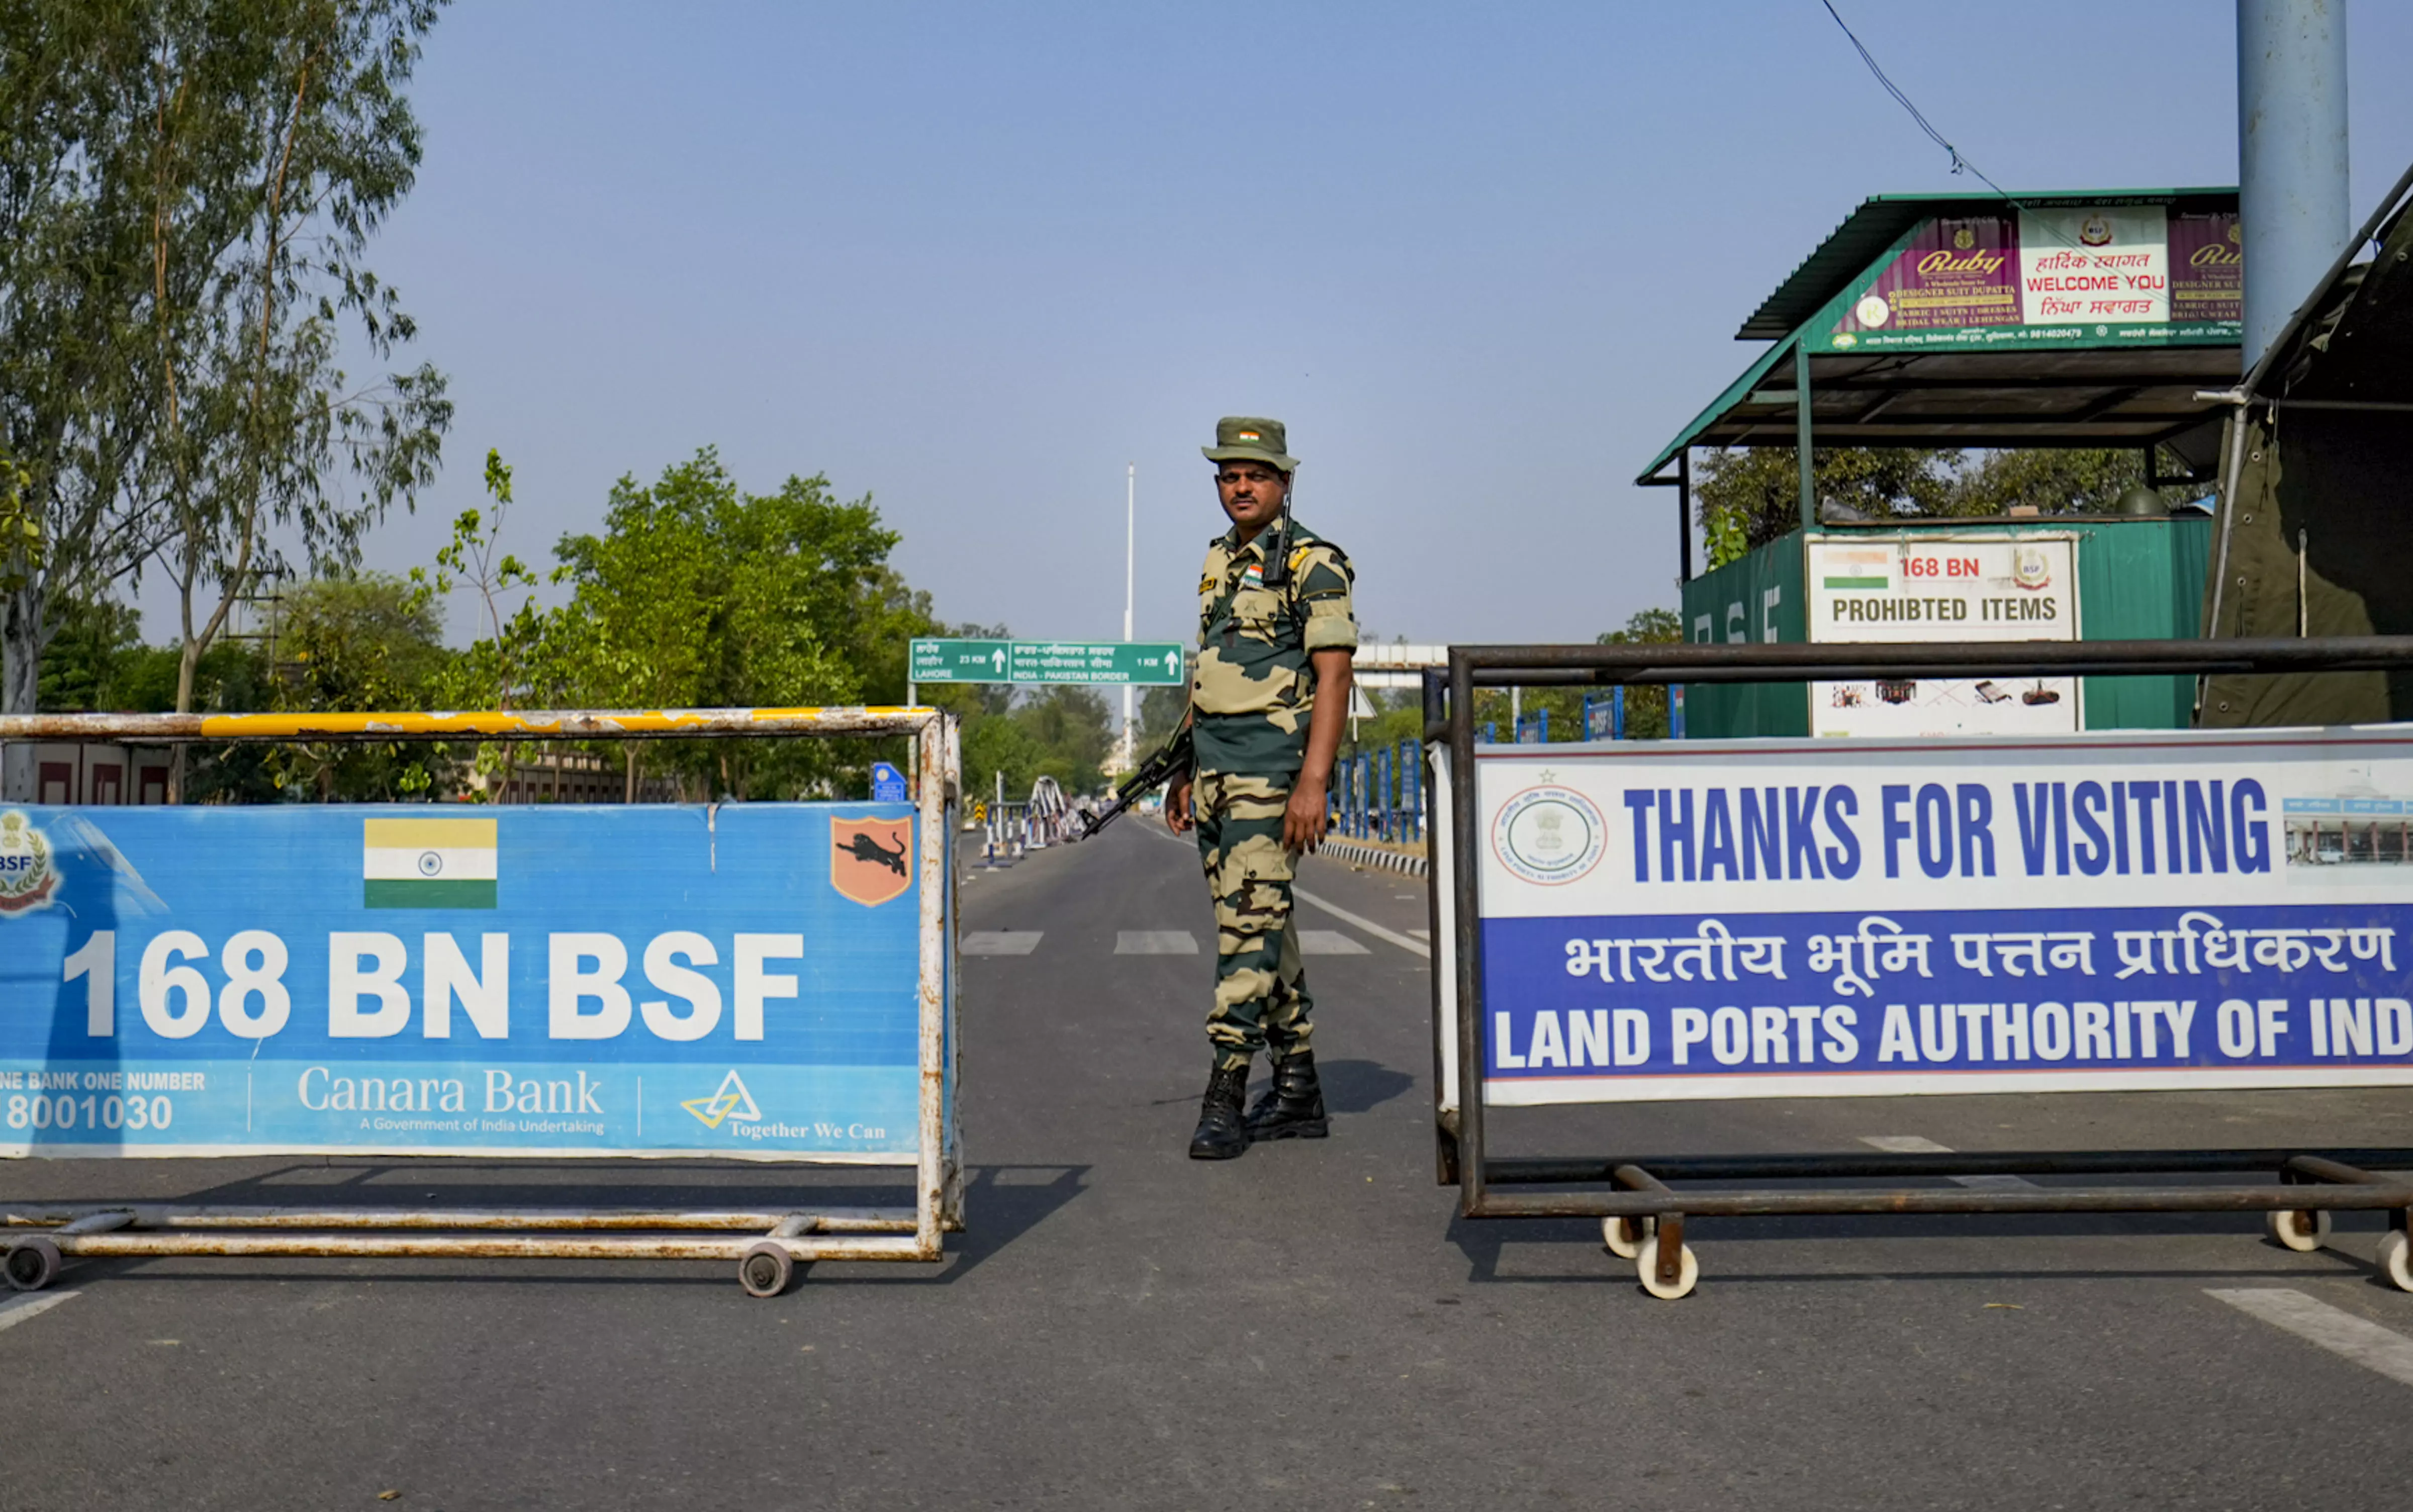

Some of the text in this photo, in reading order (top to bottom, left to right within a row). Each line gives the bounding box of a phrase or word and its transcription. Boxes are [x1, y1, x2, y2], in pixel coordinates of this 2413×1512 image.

[1917, 249, 2005, 275] Ruby
[2035, 251, 2151, 272] हार्दिक स्वागत
[1896, 285, 2015, 297] DESIGNER SUIT DUPATTA
[2026, 274, 2164, 292] WELCOME YOU
[2172, 280, 2221, 289] DESIGNER
[1898, 305, 2017, 317] FABRIC SUITS DRESSES
[2040, 296, 2153, 315] ਨਿੱਘਾ ਸਵਾਗਤ
[2173, 301, 2208, 310] FABRIC
[1932, 317, 1960, 325] WEAR
[1902, 557, 1979, 577] 168 BN
[2023, 565, 2040, 574] BSF
[1833, 597, 2056, 622] PROHIBTED ITEMS
[959, 655, 986, 665] 23 KM
[1137, 657, 1158, 667] 1 KM
[914, 669, 953, 679] LAHORE
[1013, 671, 1038, 681] INDIA
[1044, 671, 1089, 681] PAKISTAN
[1091, 672, 1130, 681] BORDER
[1624, 778, 2271, 883] THANKS FOR VISITING
[1564, 911, 2396, 998] भारतीय भूमि पत्तन प्राधिकरण
[64, 930, 803, 1041] 168 BN BSF
[1494, 997, 2412, 1069] LAND PORTS AUTHORITY OF IND
[29, 1072, 78, 1090] BANK
[84, 1072, 121, 1090] ONE
[127, 1072, 205, 1090] NUMBER
[298, 1067, 604, 1113] Canara Bank
[7, 1095, 171, 1129] 8001030
[360, 1118, 604, 1136] A Government of India Undertaking
[728, 1121, 886, 1141] Together We Can
